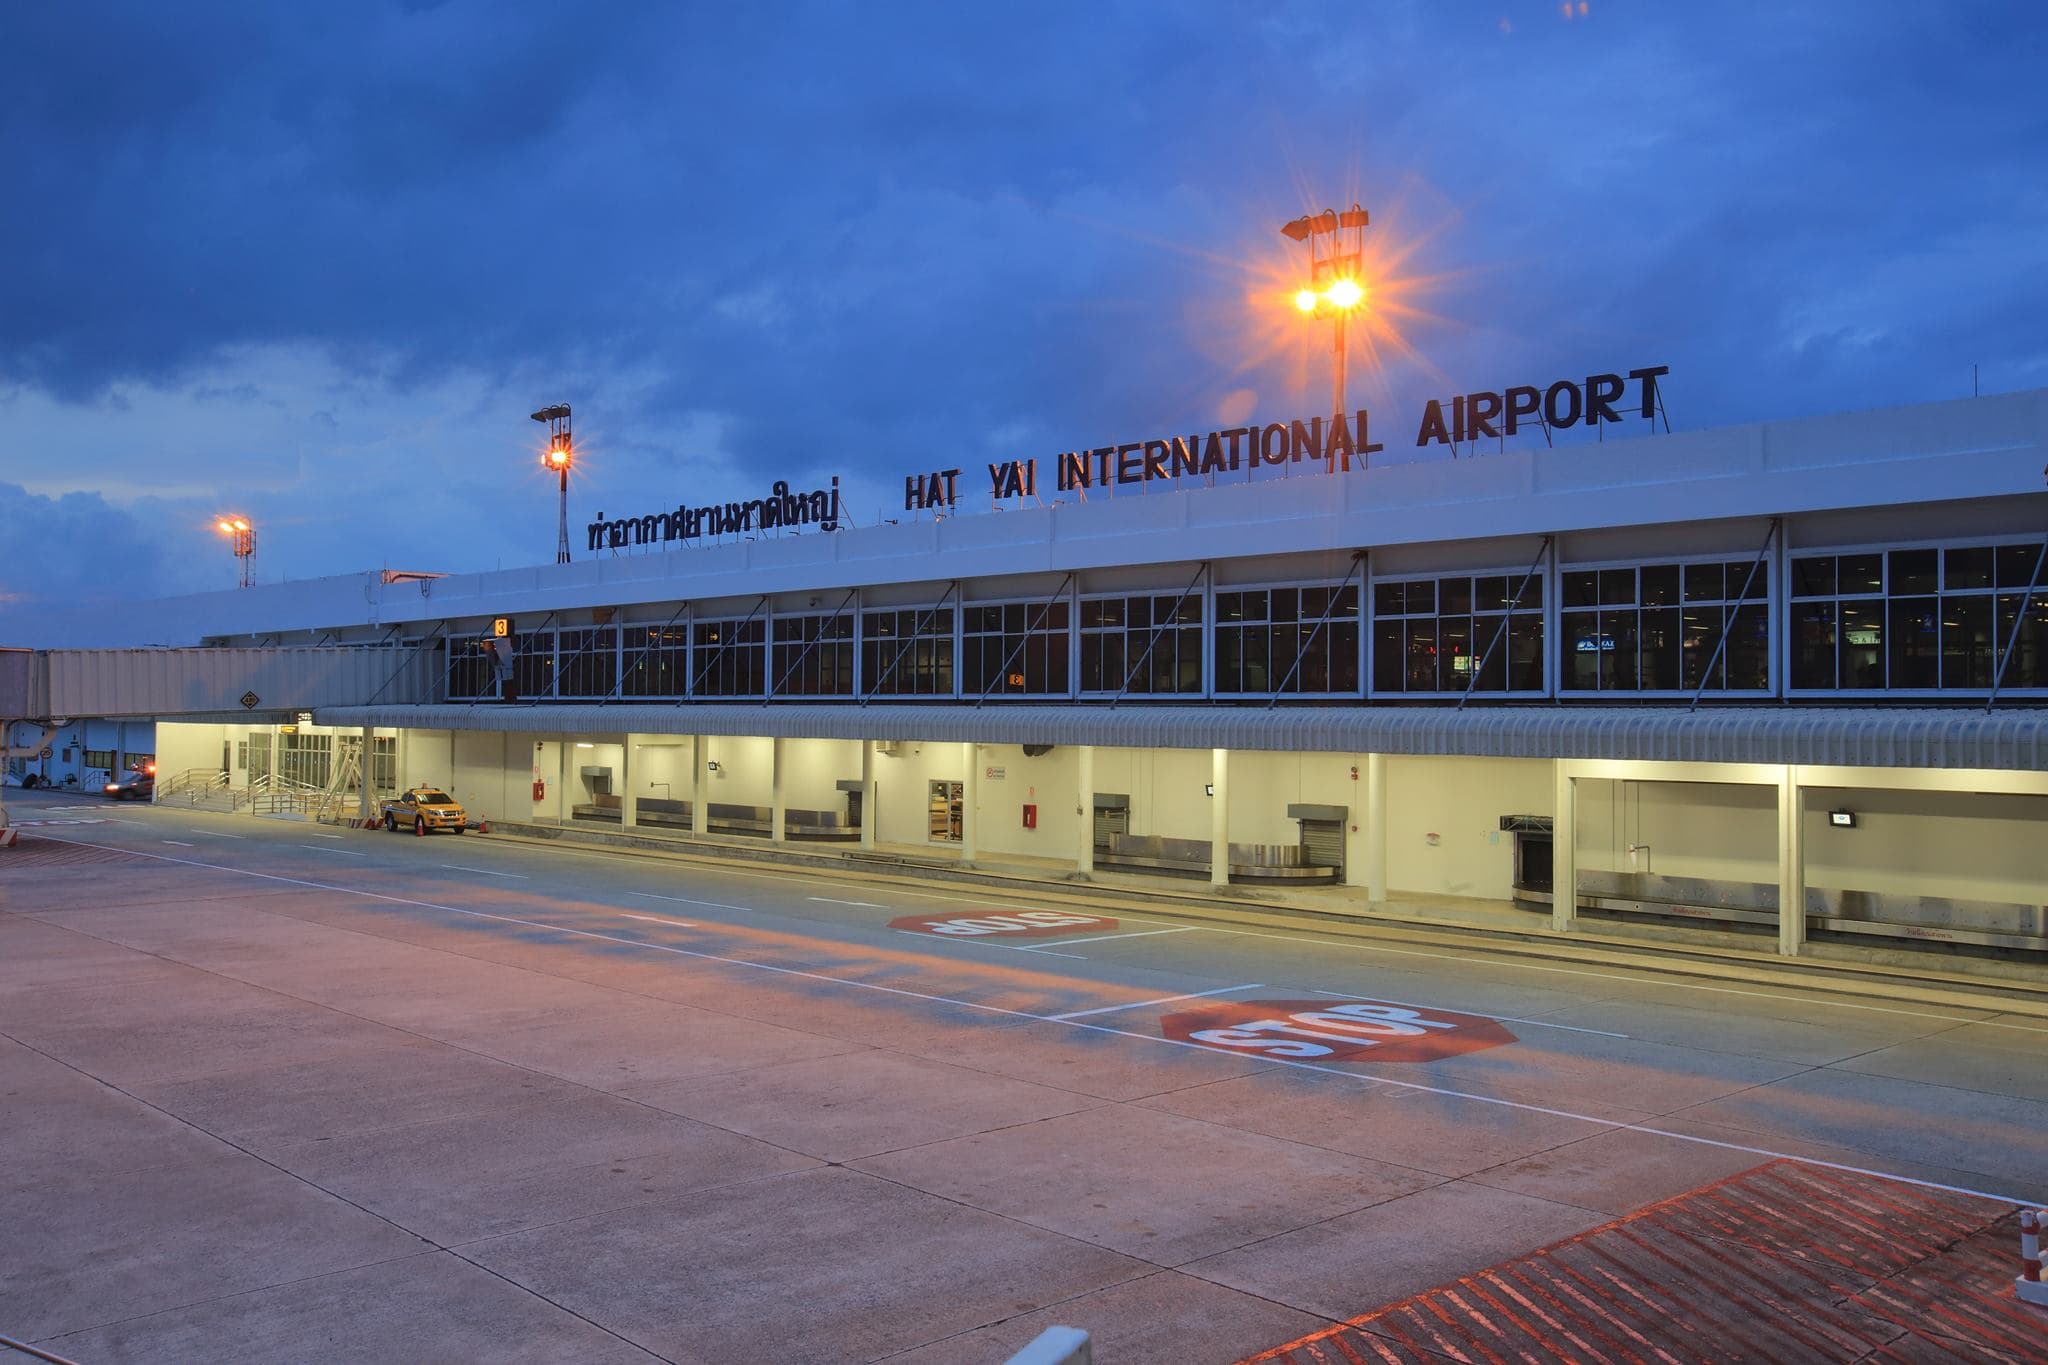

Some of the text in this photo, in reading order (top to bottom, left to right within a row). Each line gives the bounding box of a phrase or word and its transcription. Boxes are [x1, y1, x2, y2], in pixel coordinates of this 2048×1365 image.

[905, 366, 1669, 510] HAT YAI INTERNATIONAL AIRPORT
[588, 476, 839, 550] ท่าอากาศยานหาดใหญ่
[498, 621, 505, 634] 3
[921, 912, 1100, 935] STOP
[1189, 1004, 1457, 1057] STOP
